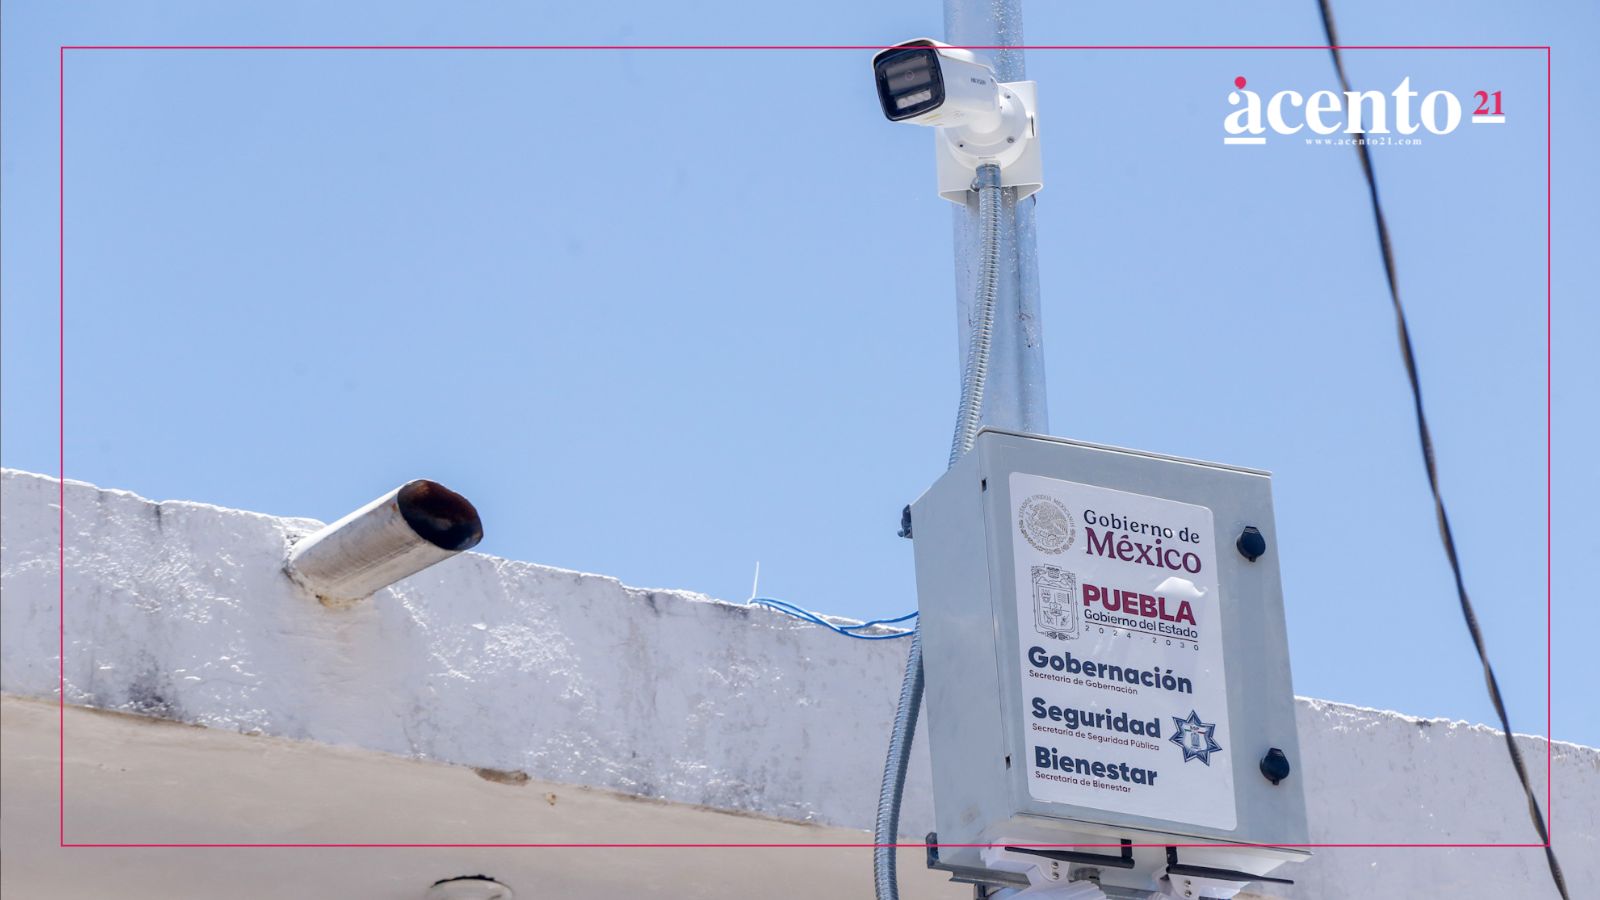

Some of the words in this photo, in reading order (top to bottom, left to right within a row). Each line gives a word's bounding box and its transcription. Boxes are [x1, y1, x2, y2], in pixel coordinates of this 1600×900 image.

[1084, 509, 1174, 539] Gobierno
[1179, 527, 1200, 544] de
[1085, 526, 1202, 574] México
[1082, 583, 1197, 626] PUEBLA
[1084, 608, 1137, 628] Gobierno
[1139, 618, 1157, 631] del
[1159, 622, 1198, 639] Estado
[1028, 646, 1193, 694] Gobernación
[1073, 676, 1084, 686] de
[1085, 678, 1138, 695] Gobernación
[1031, 697, 1161, 739] Seguridad
[1075, 729, 1086, 739] de
[1087, 731, 1129, 747] Seguridad
[1130, 738, 1160, 751] Pública
[1034, 745, 1158, 786] Bienestar
[1080, 777, 1091, 787] de
[1092, 779, 1131, 793] Bienestar
